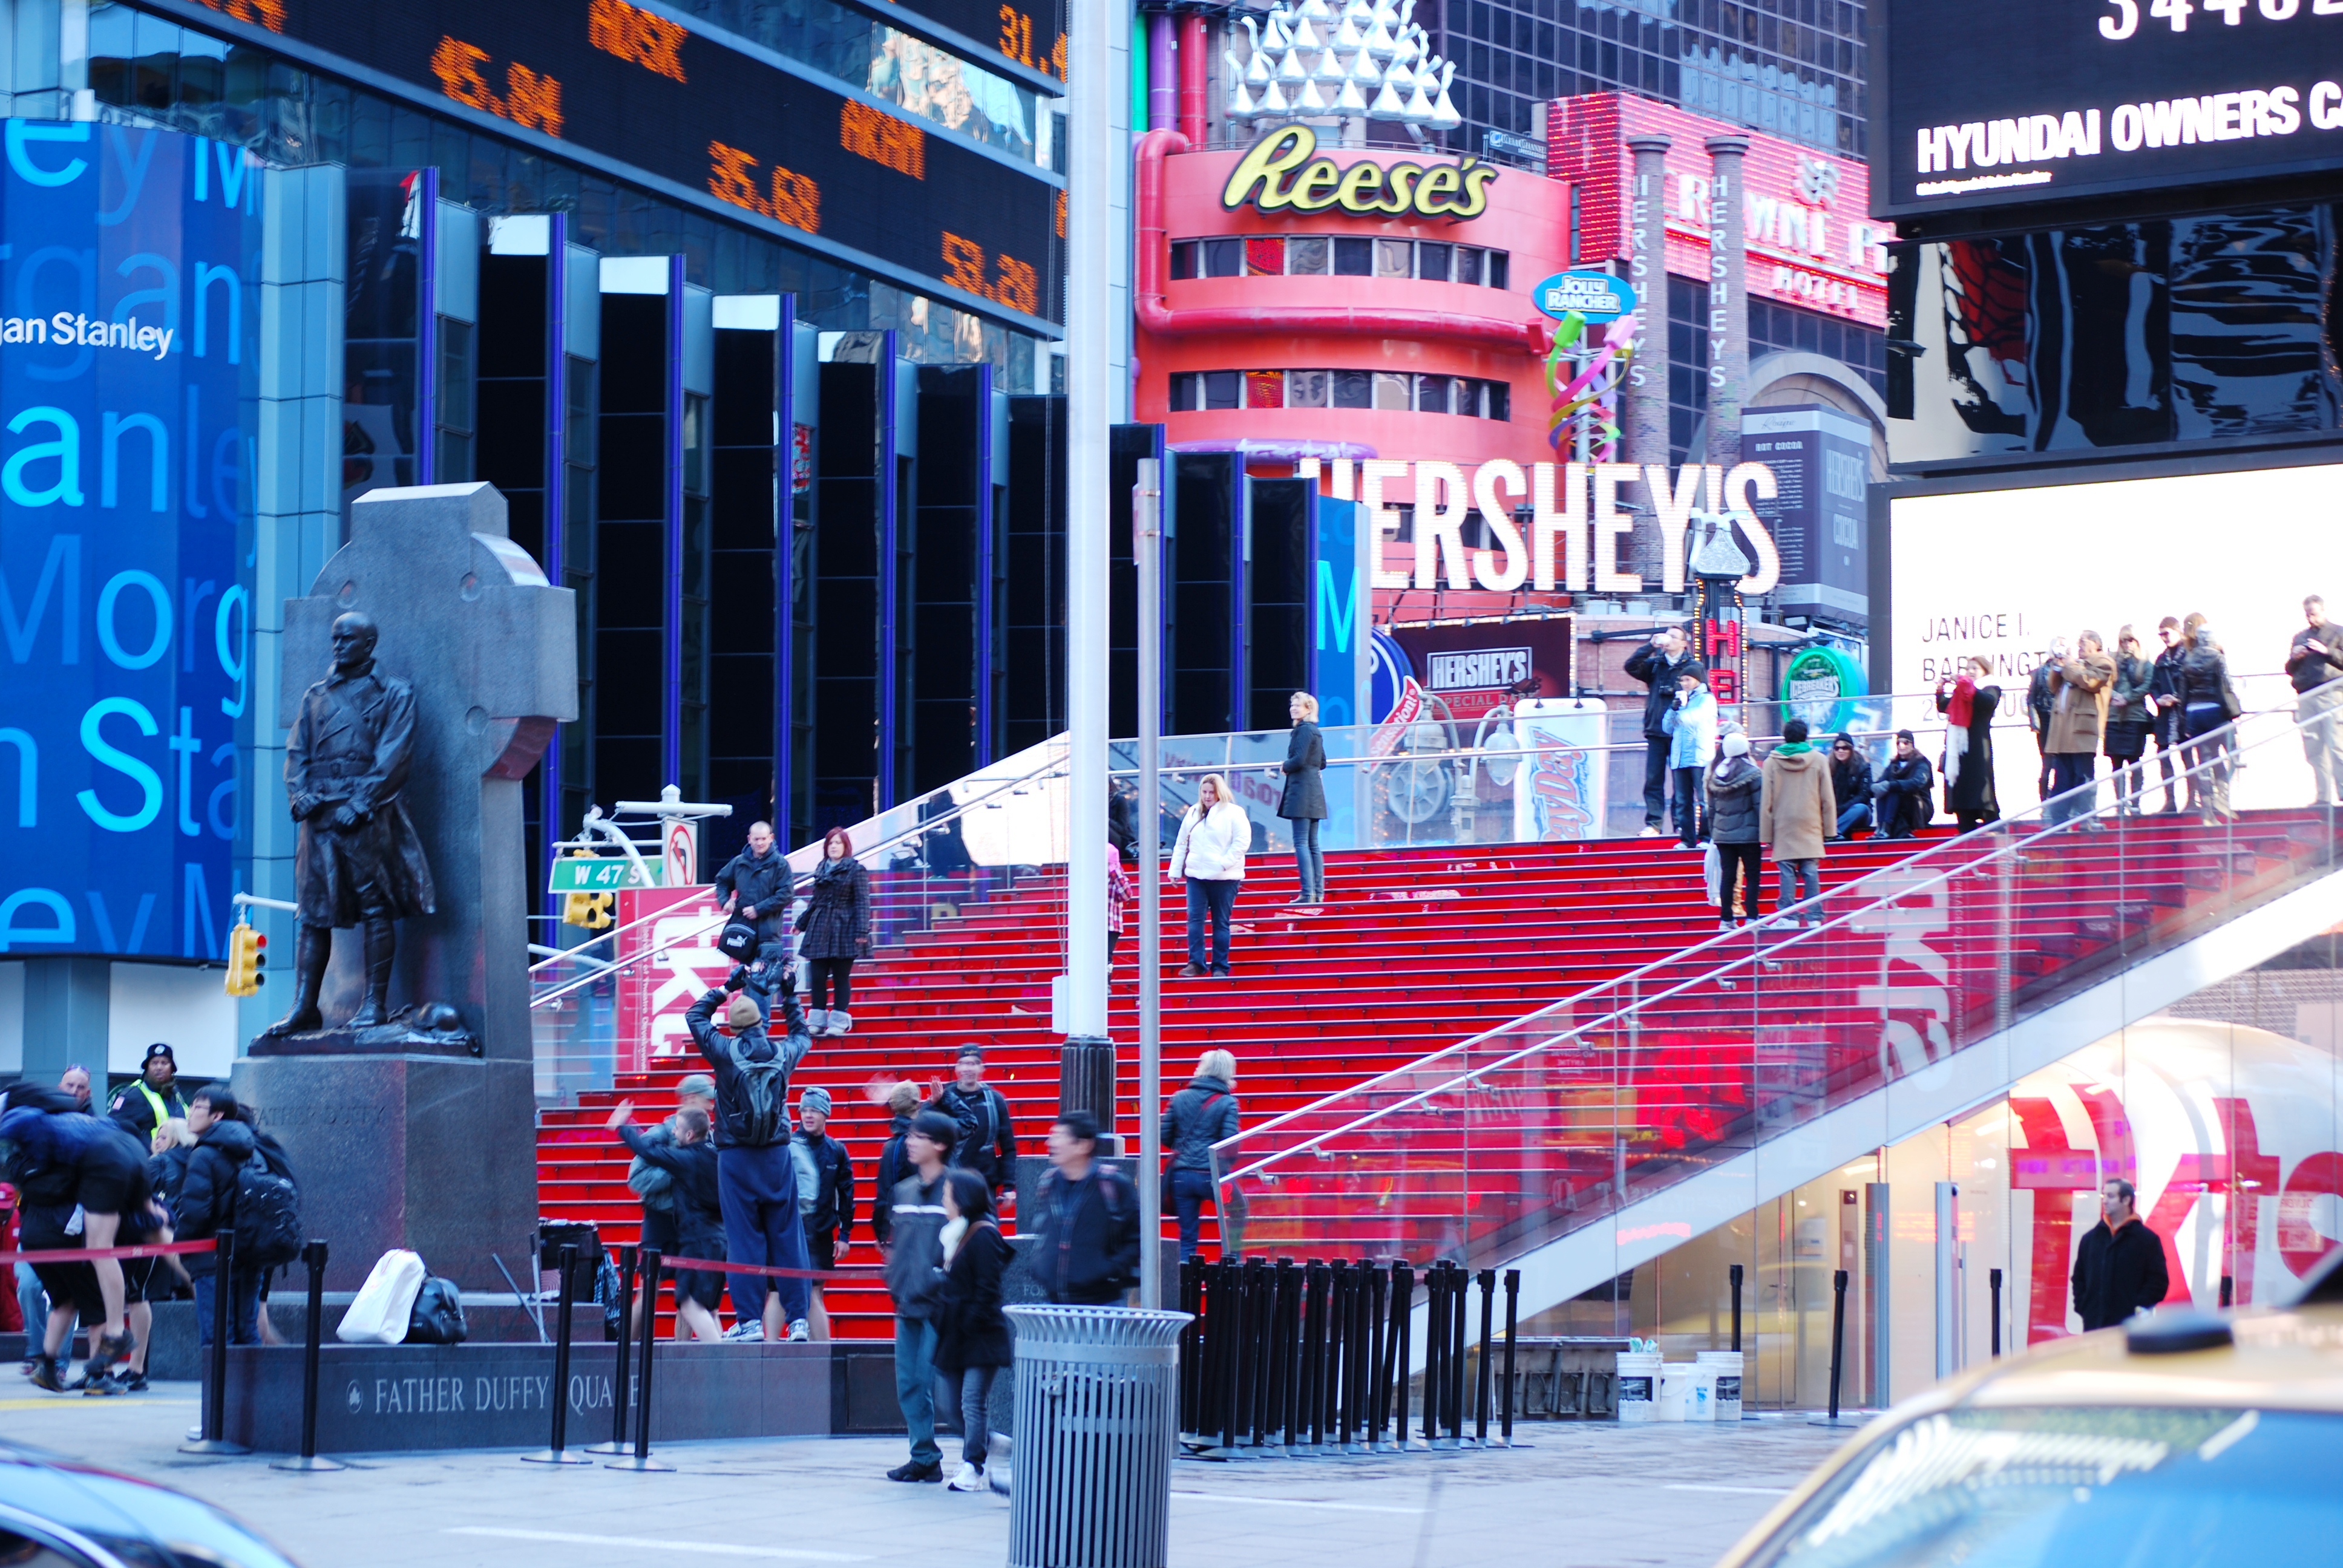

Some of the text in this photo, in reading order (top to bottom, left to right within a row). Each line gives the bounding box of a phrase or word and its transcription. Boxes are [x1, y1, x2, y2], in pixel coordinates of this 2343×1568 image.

[1917, 109, 2101, 173] HYUNDAI
[2111, 86, 2301, 152] OWNERS
[1222, 124, 1496, 218] Reese's
[1547, 292, 1617, 310] RANCHER
[1561, 278, 1605, 295] JOLLY
[1709, 175, 1728, 389] HERSHEYS
[1774, 265, 1861, 310] HOTEL
[51, 311, 174, 361] Stanley
[1299, 457, 1781, 595] ERSHEY'S
[1922, 613, 2007, 642] JANICE
[1432, 651, 1527, 689] HERSHEY'S
[575, 865, 592, 885] W
[595, 864, 625, 885] 47
[375, 1377, 465, 1414] FATHER
[476, 1376, 549, 1411] DUFFY
